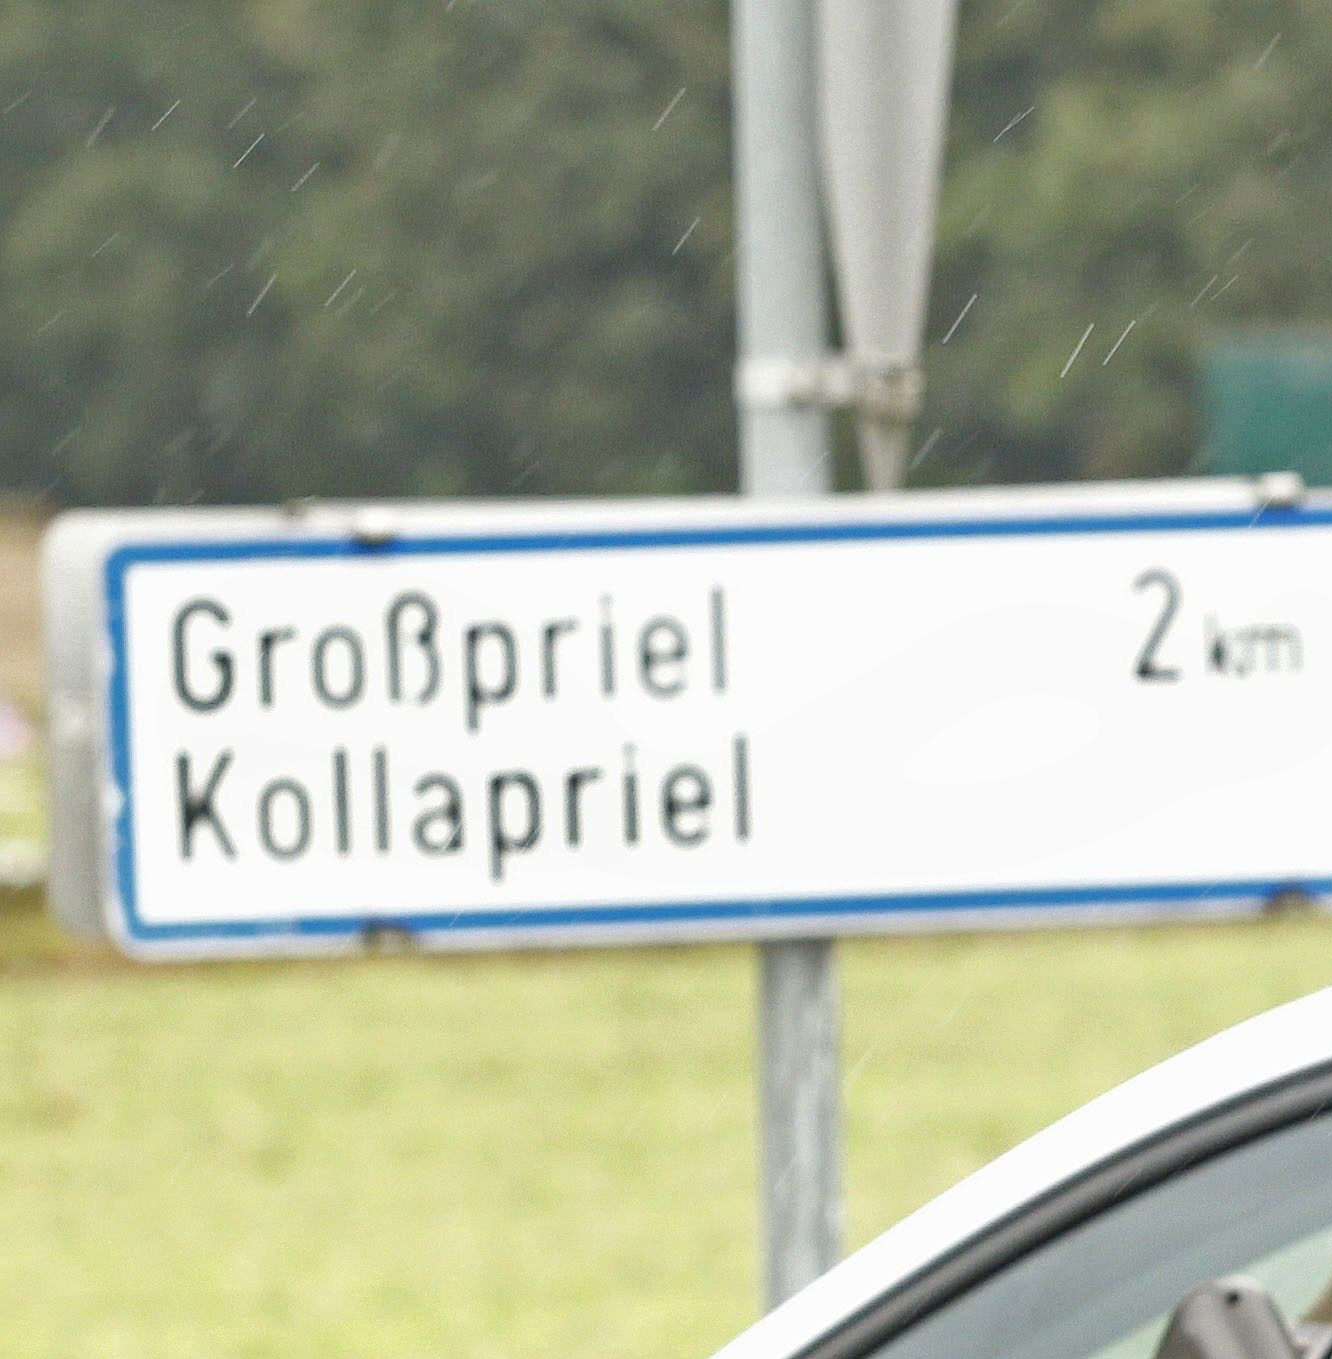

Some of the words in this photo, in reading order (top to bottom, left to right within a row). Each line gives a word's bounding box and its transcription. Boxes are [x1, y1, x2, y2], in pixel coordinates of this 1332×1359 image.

[169, 588, 728, 730] Großpriel
[1132, 567, 1183, 685] 2
[1203, 612, 1303, 680] km
[173, 736, 753, 882] Kollapriel
